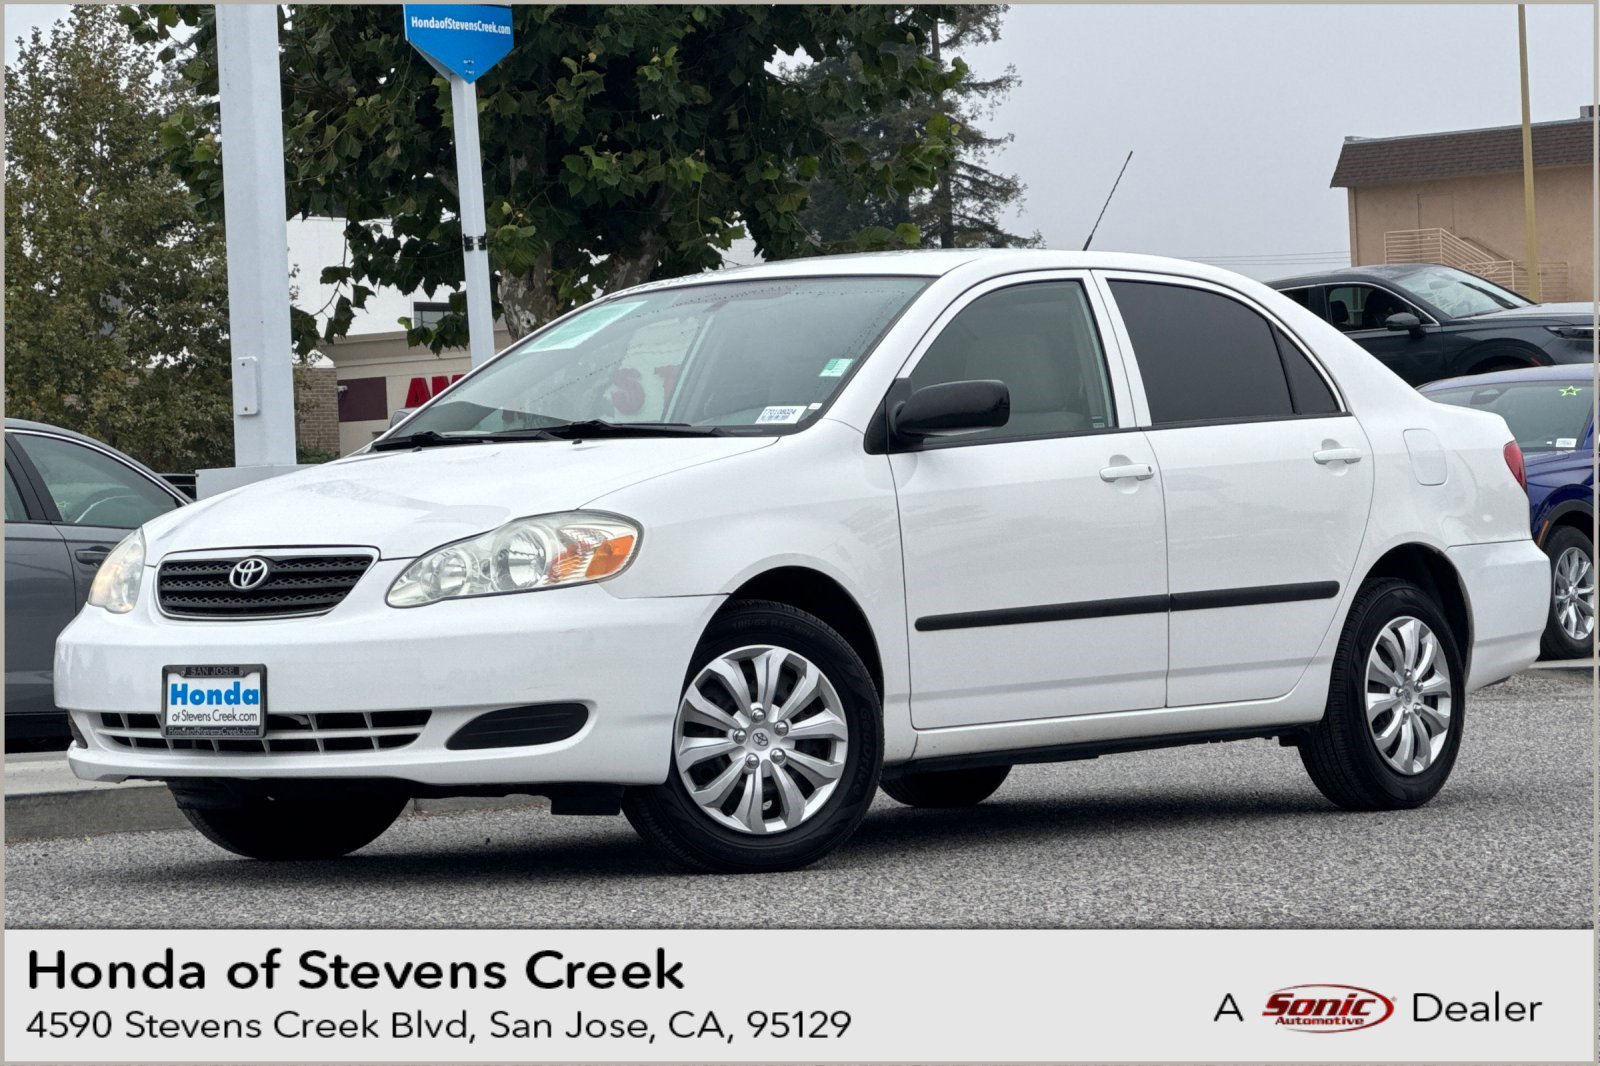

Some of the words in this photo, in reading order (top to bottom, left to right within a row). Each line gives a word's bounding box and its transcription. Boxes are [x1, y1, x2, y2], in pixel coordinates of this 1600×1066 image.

[411, 16, 511, 35] HondaofStevensCreek.com
[191, 667, 209, 676] SAN
[211, 667, 235, 676] JOSE
[170, 681, 259, 706] Honda
